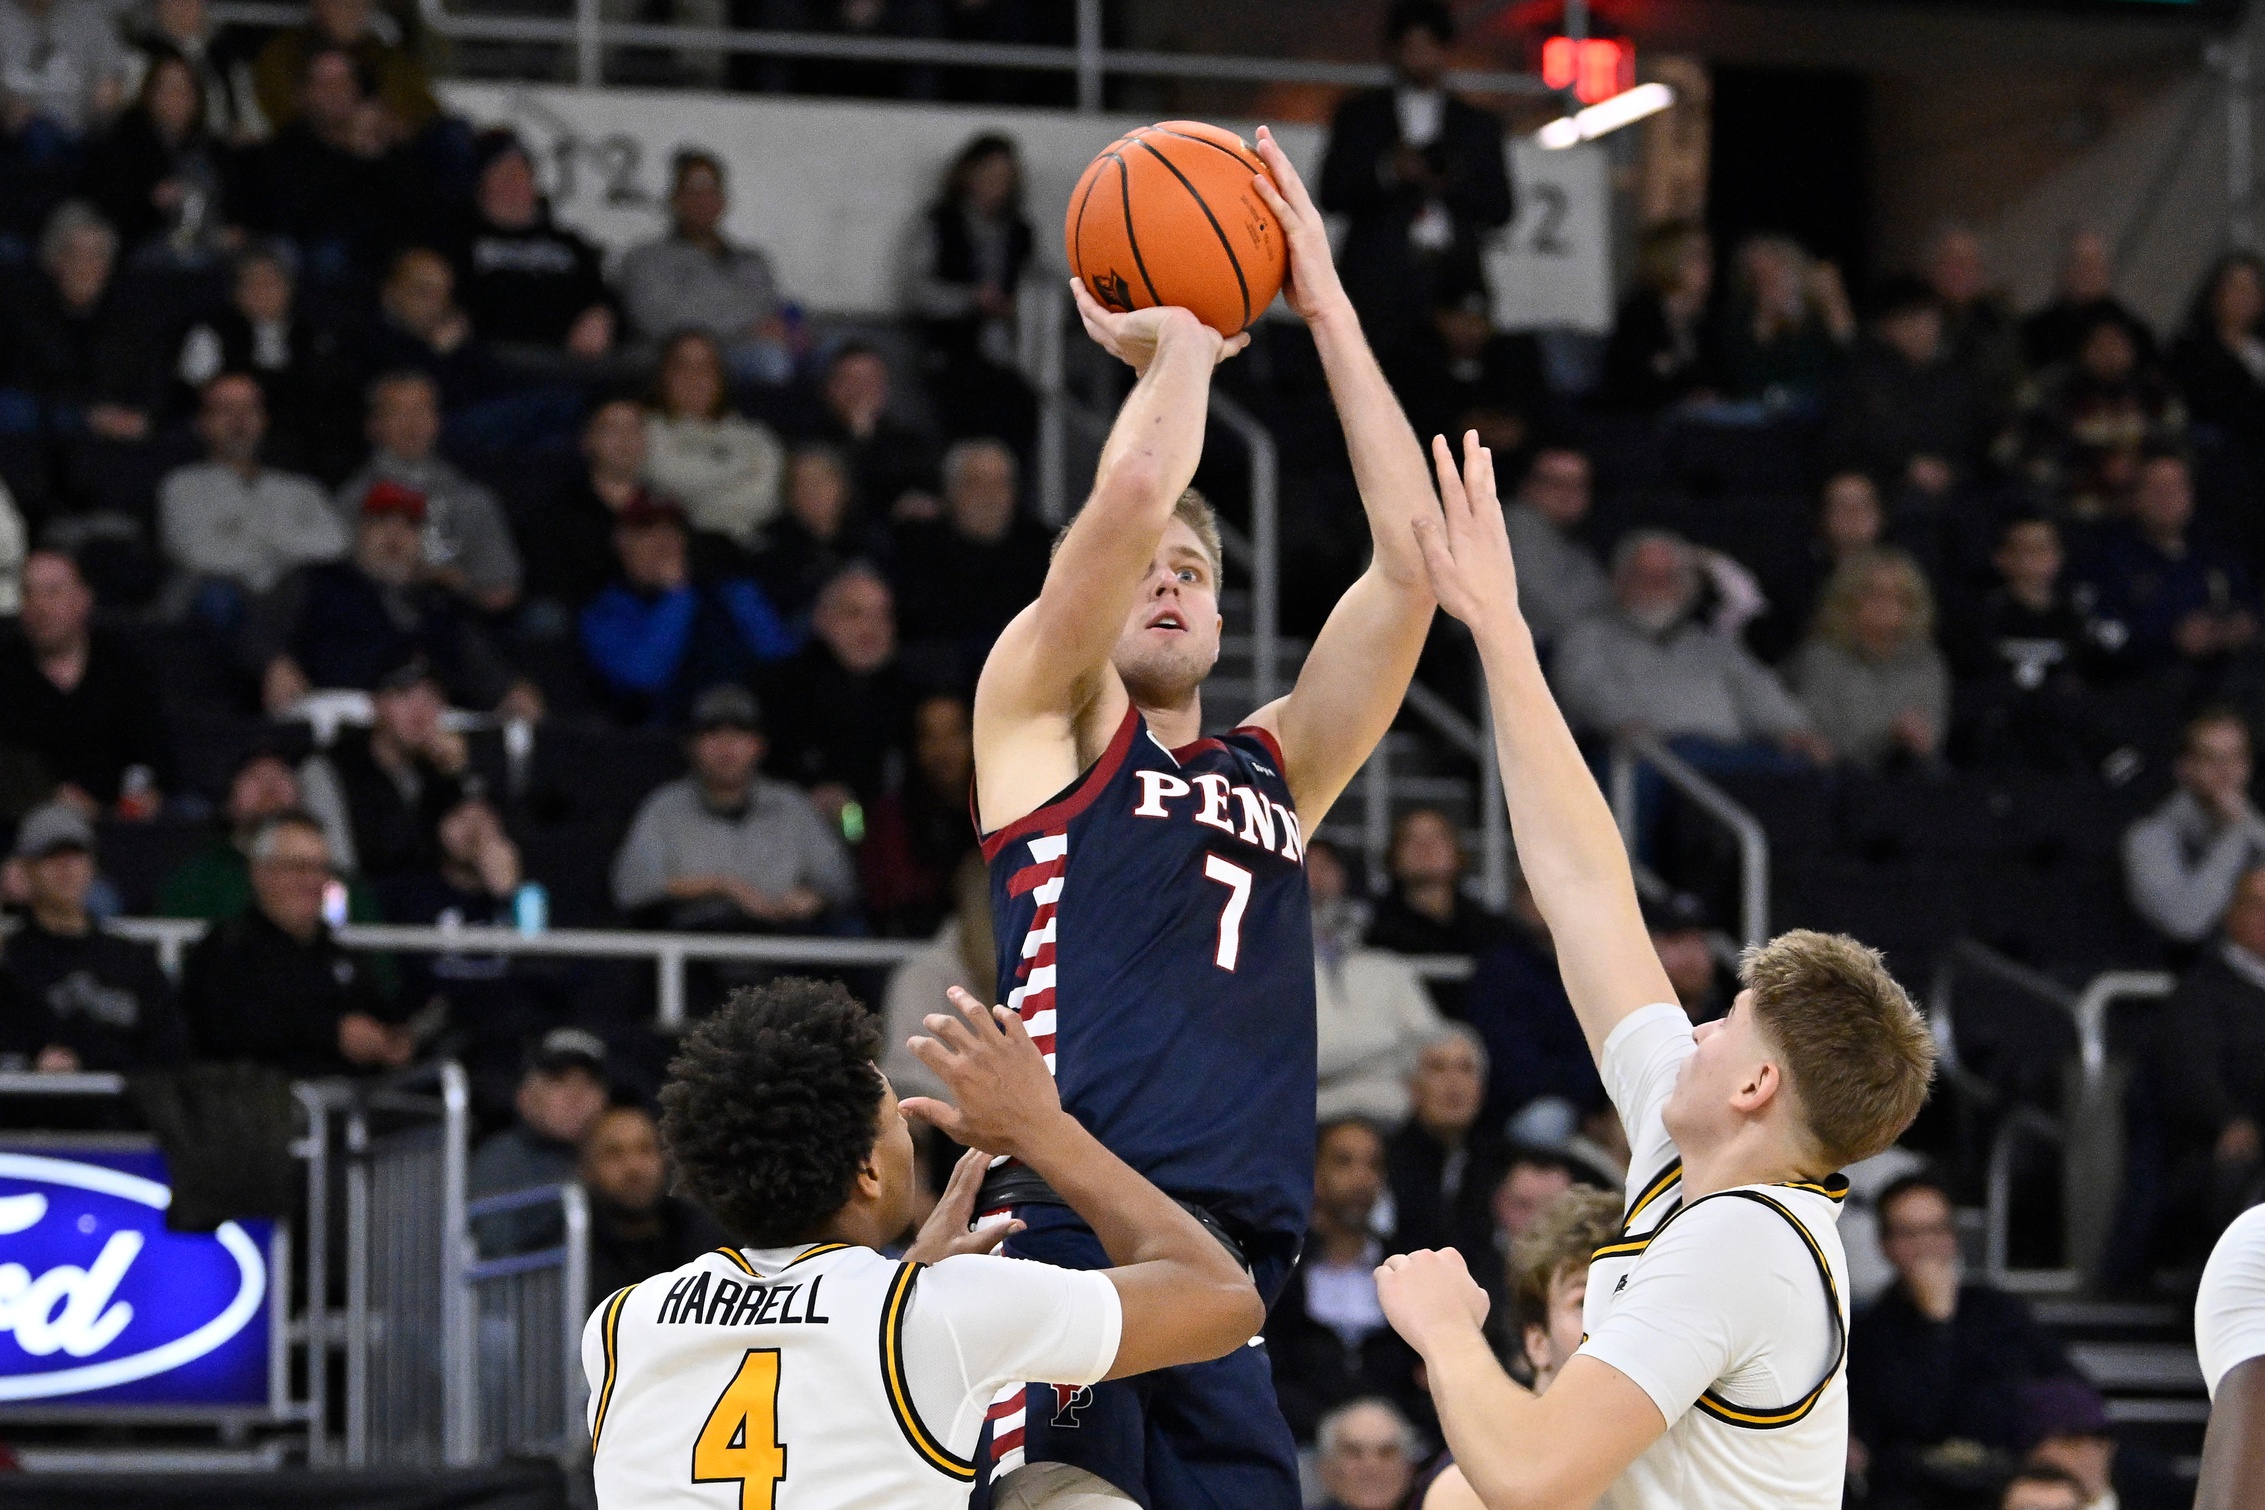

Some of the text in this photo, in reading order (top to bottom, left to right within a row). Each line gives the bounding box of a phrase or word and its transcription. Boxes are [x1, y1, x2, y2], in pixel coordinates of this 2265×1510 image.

[1133, 769, 1303, 866] PENN
[1203, 851, 1254, 973] 7
[656, 1271, 829, 1326] HARRELL
[691, 1347, 787, 1510] 4
[1050, 1383, 1093, 1428] P
